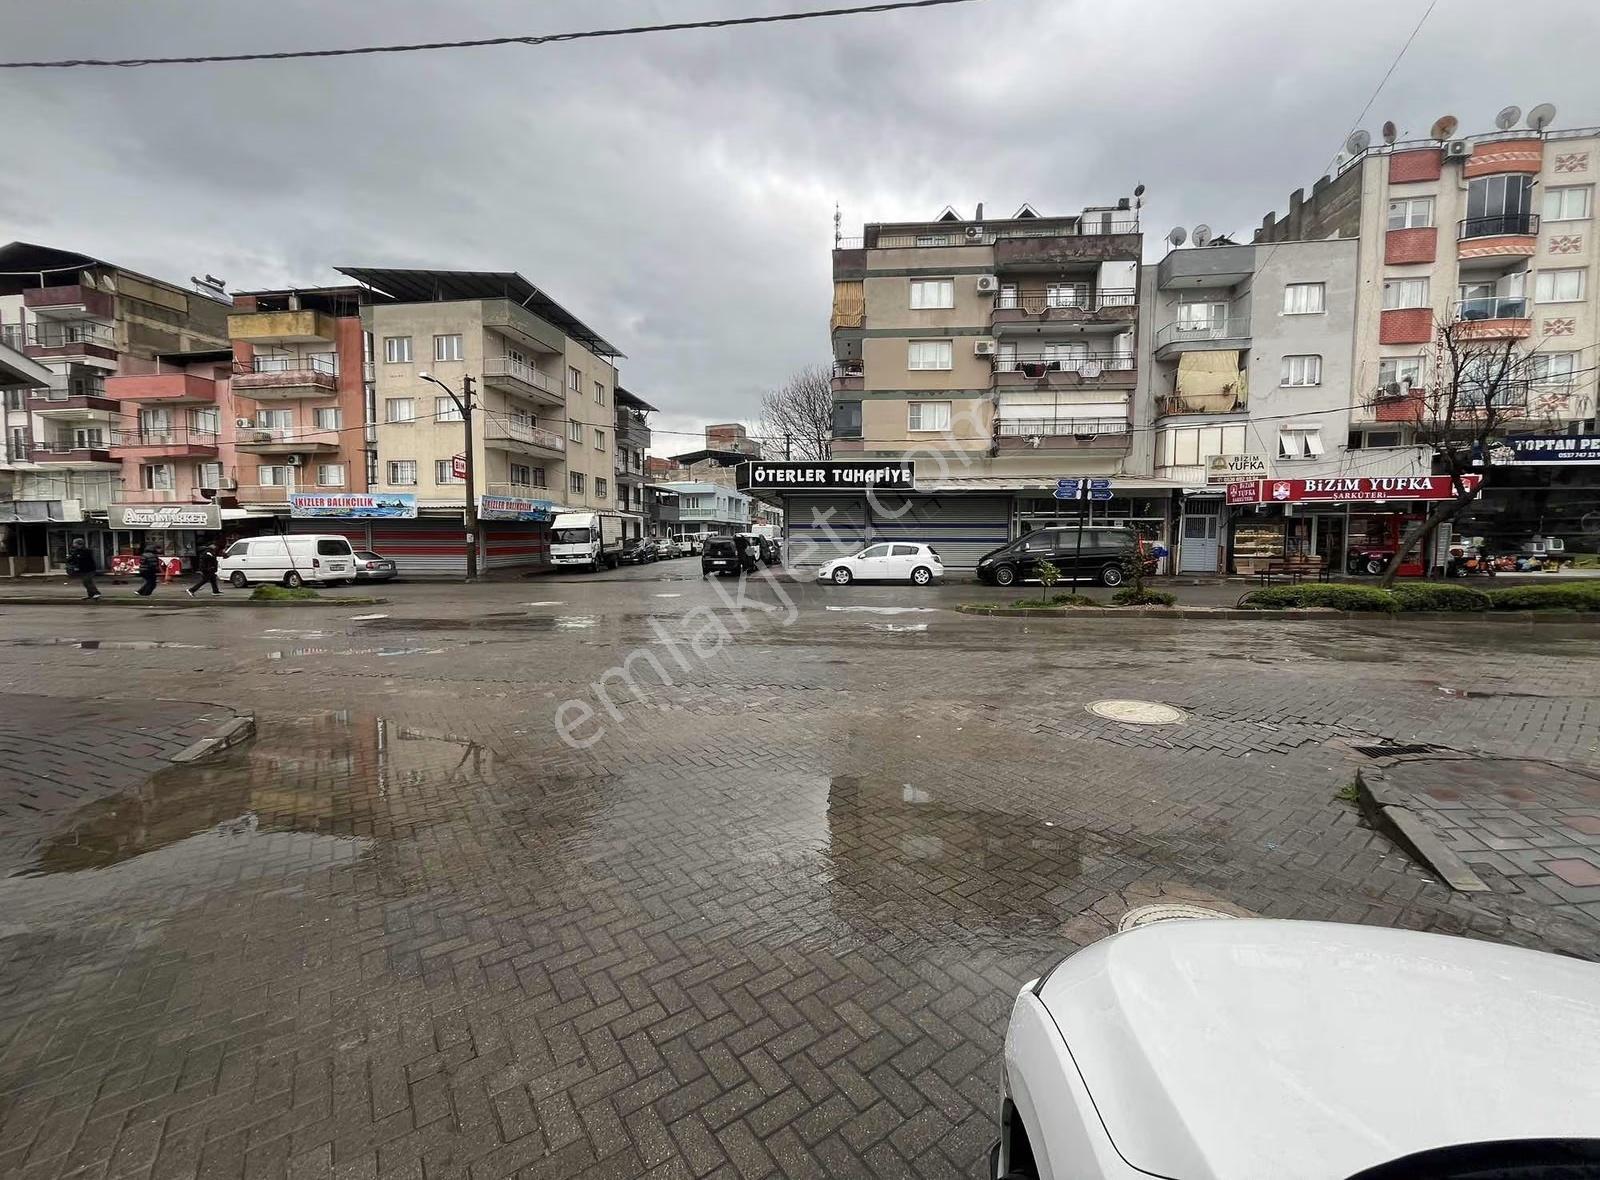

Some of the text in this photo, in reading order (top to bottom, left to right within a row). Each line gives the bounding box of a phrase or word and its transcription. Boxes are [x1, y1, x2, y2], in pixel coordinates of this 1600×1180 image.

[1515, 440, 1576, 450] TOPTAN
[1228, 461, 1265, 470] YUFKA
[755, 466, 911, 483] ÖTERLER TUHAFİYE
[1369, 477, 1434, 491] YUFKA
